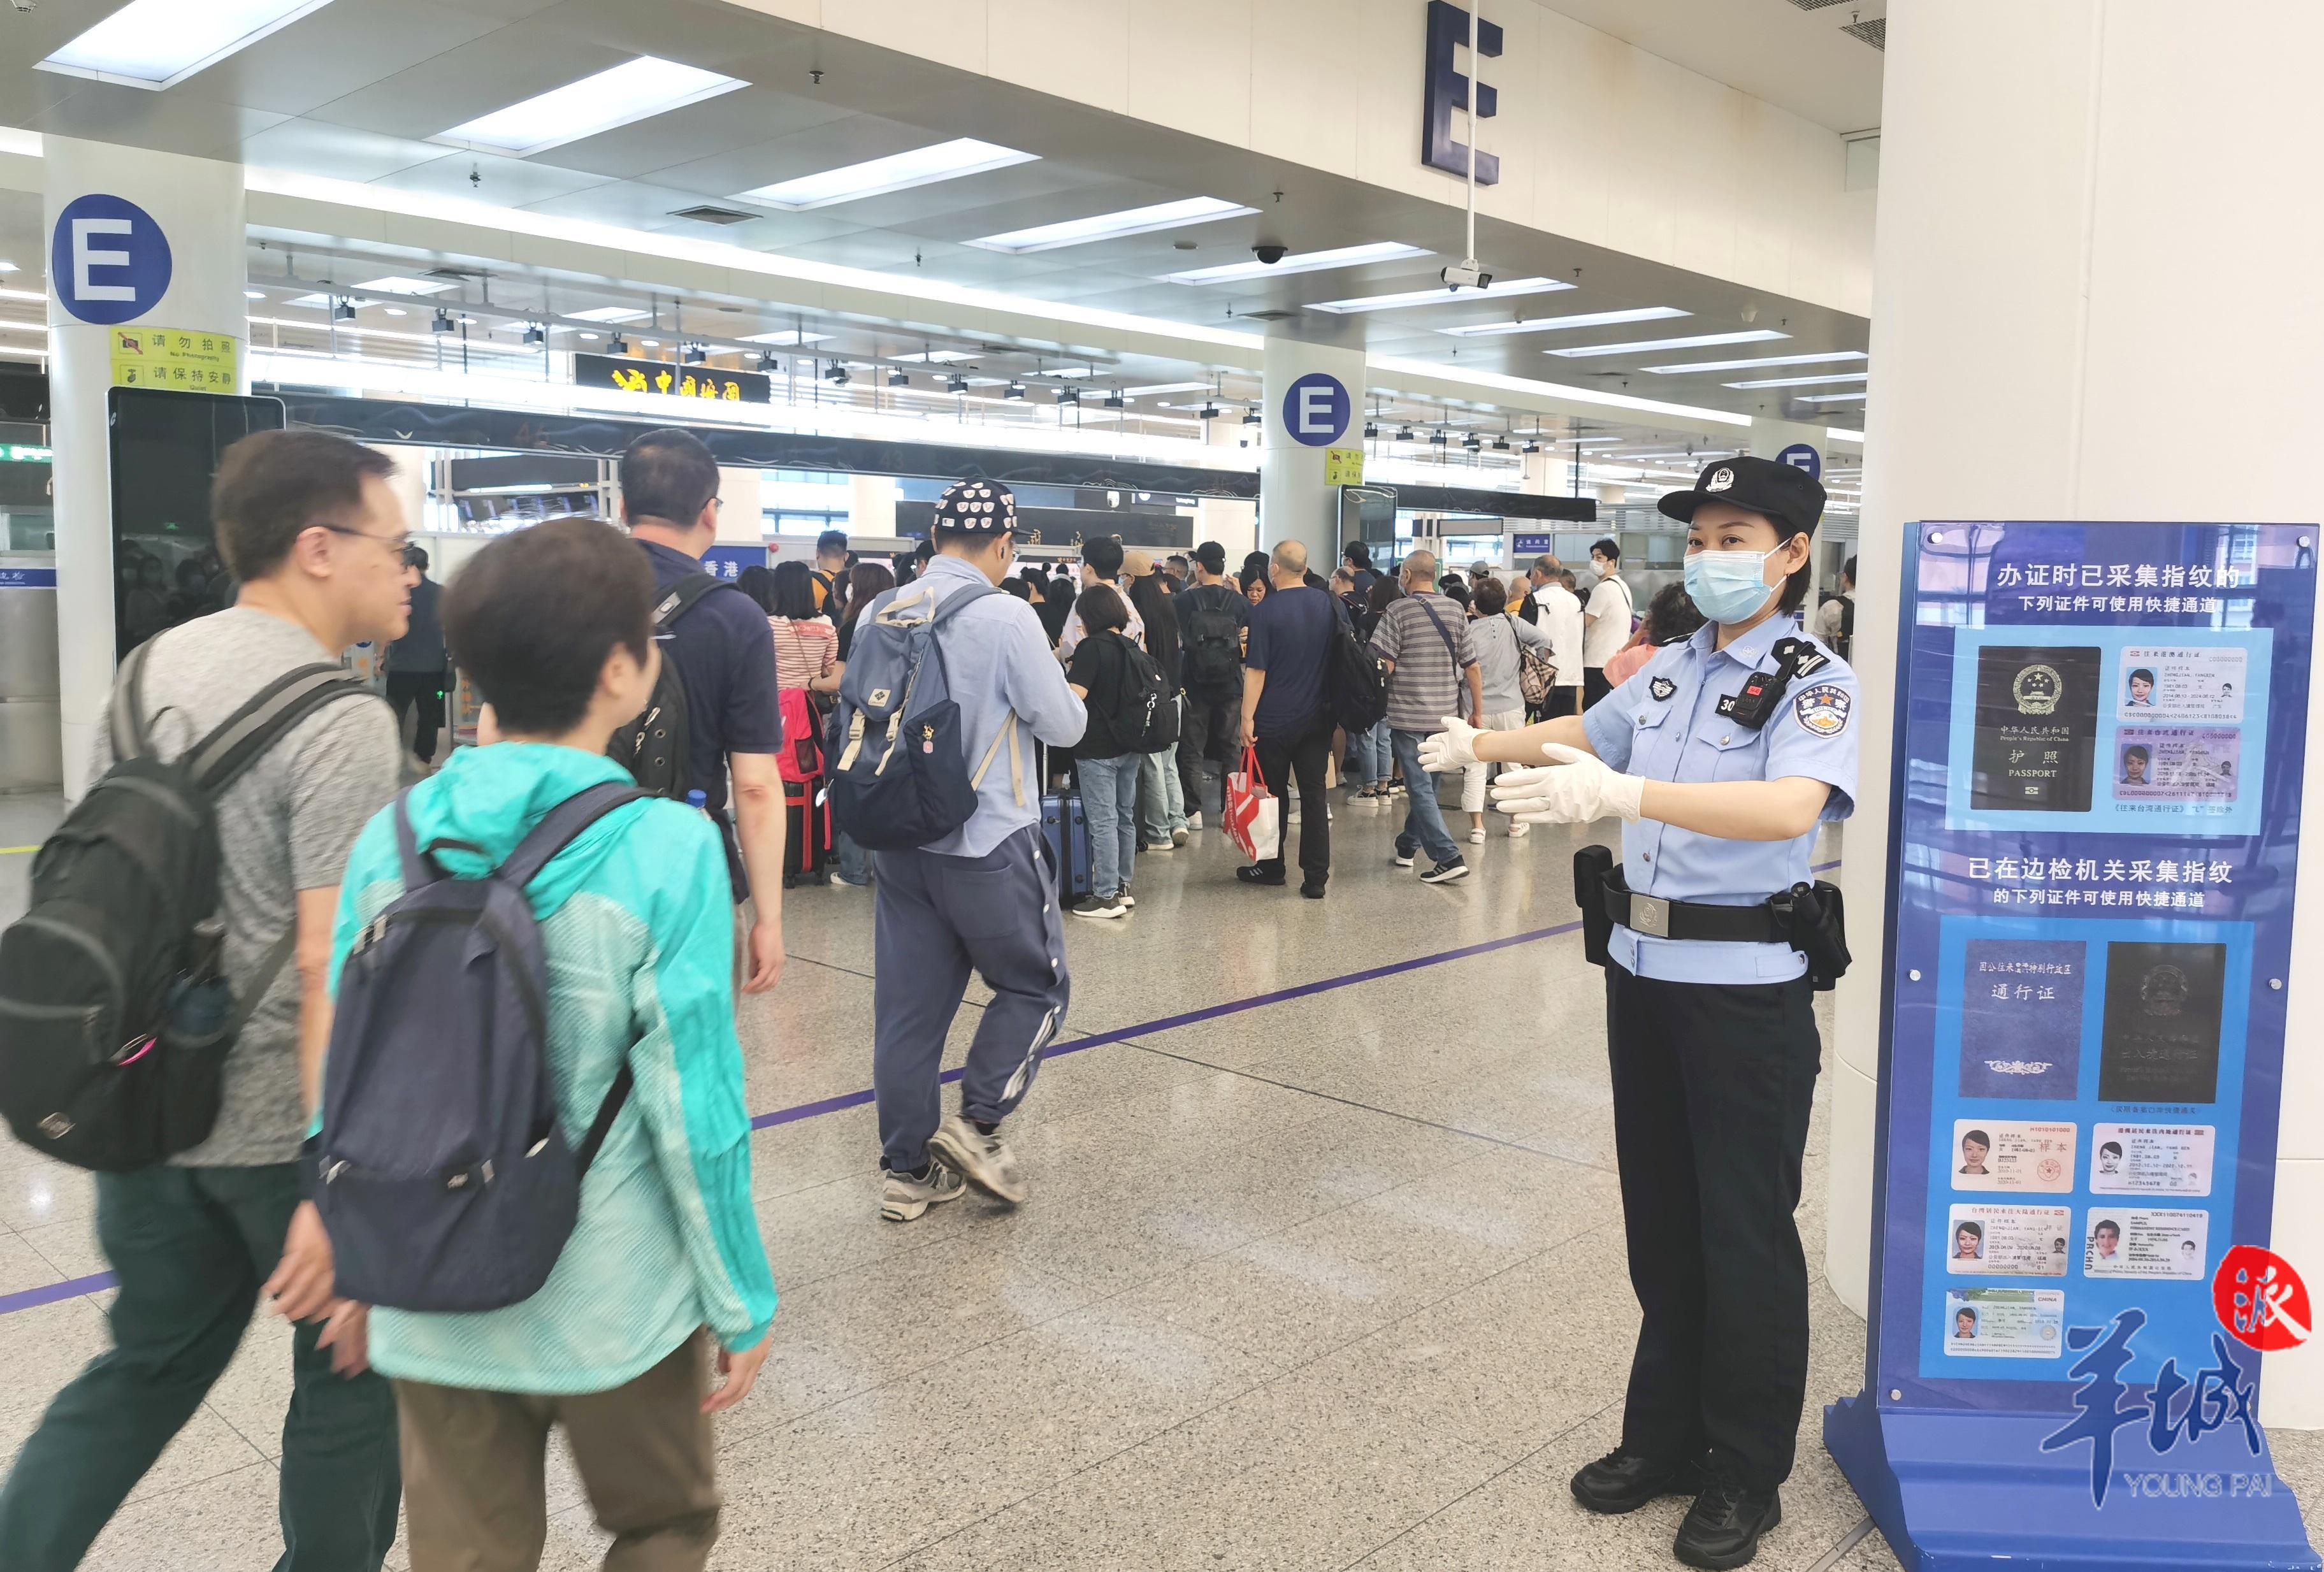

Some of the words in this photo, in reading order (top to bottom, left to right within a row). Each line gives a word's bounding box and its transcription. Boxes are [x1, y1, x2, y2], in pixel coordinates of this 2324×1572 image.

[1422, 0, 1503, 186] E
[72, 219, 136, 302] E
[152, 335, 231, 353] 请勿拍照
[154, 366, 231, 385] 请保持安静
[1299, 386, 1334, 433] E
[704, 560, 738, 577] 香港
[1997, 562, 2239, 588] 办证时已采集指纹的
[2019, 595, 2217, 613] 下列证件可使用快捷通道
[2000, 725, 2070, 735] 中华人民共和国
[2008, 749, 2058, 764] 护照
[2009, 769, 2057, 777] PASSPORT
[1968, 857, 2233, 884] 已在边检机关采集指纹
[1993, 888, 2205, 907] 的下列证件可使用快捷通道
[1991, 983, 2055, 1001] 通行证
